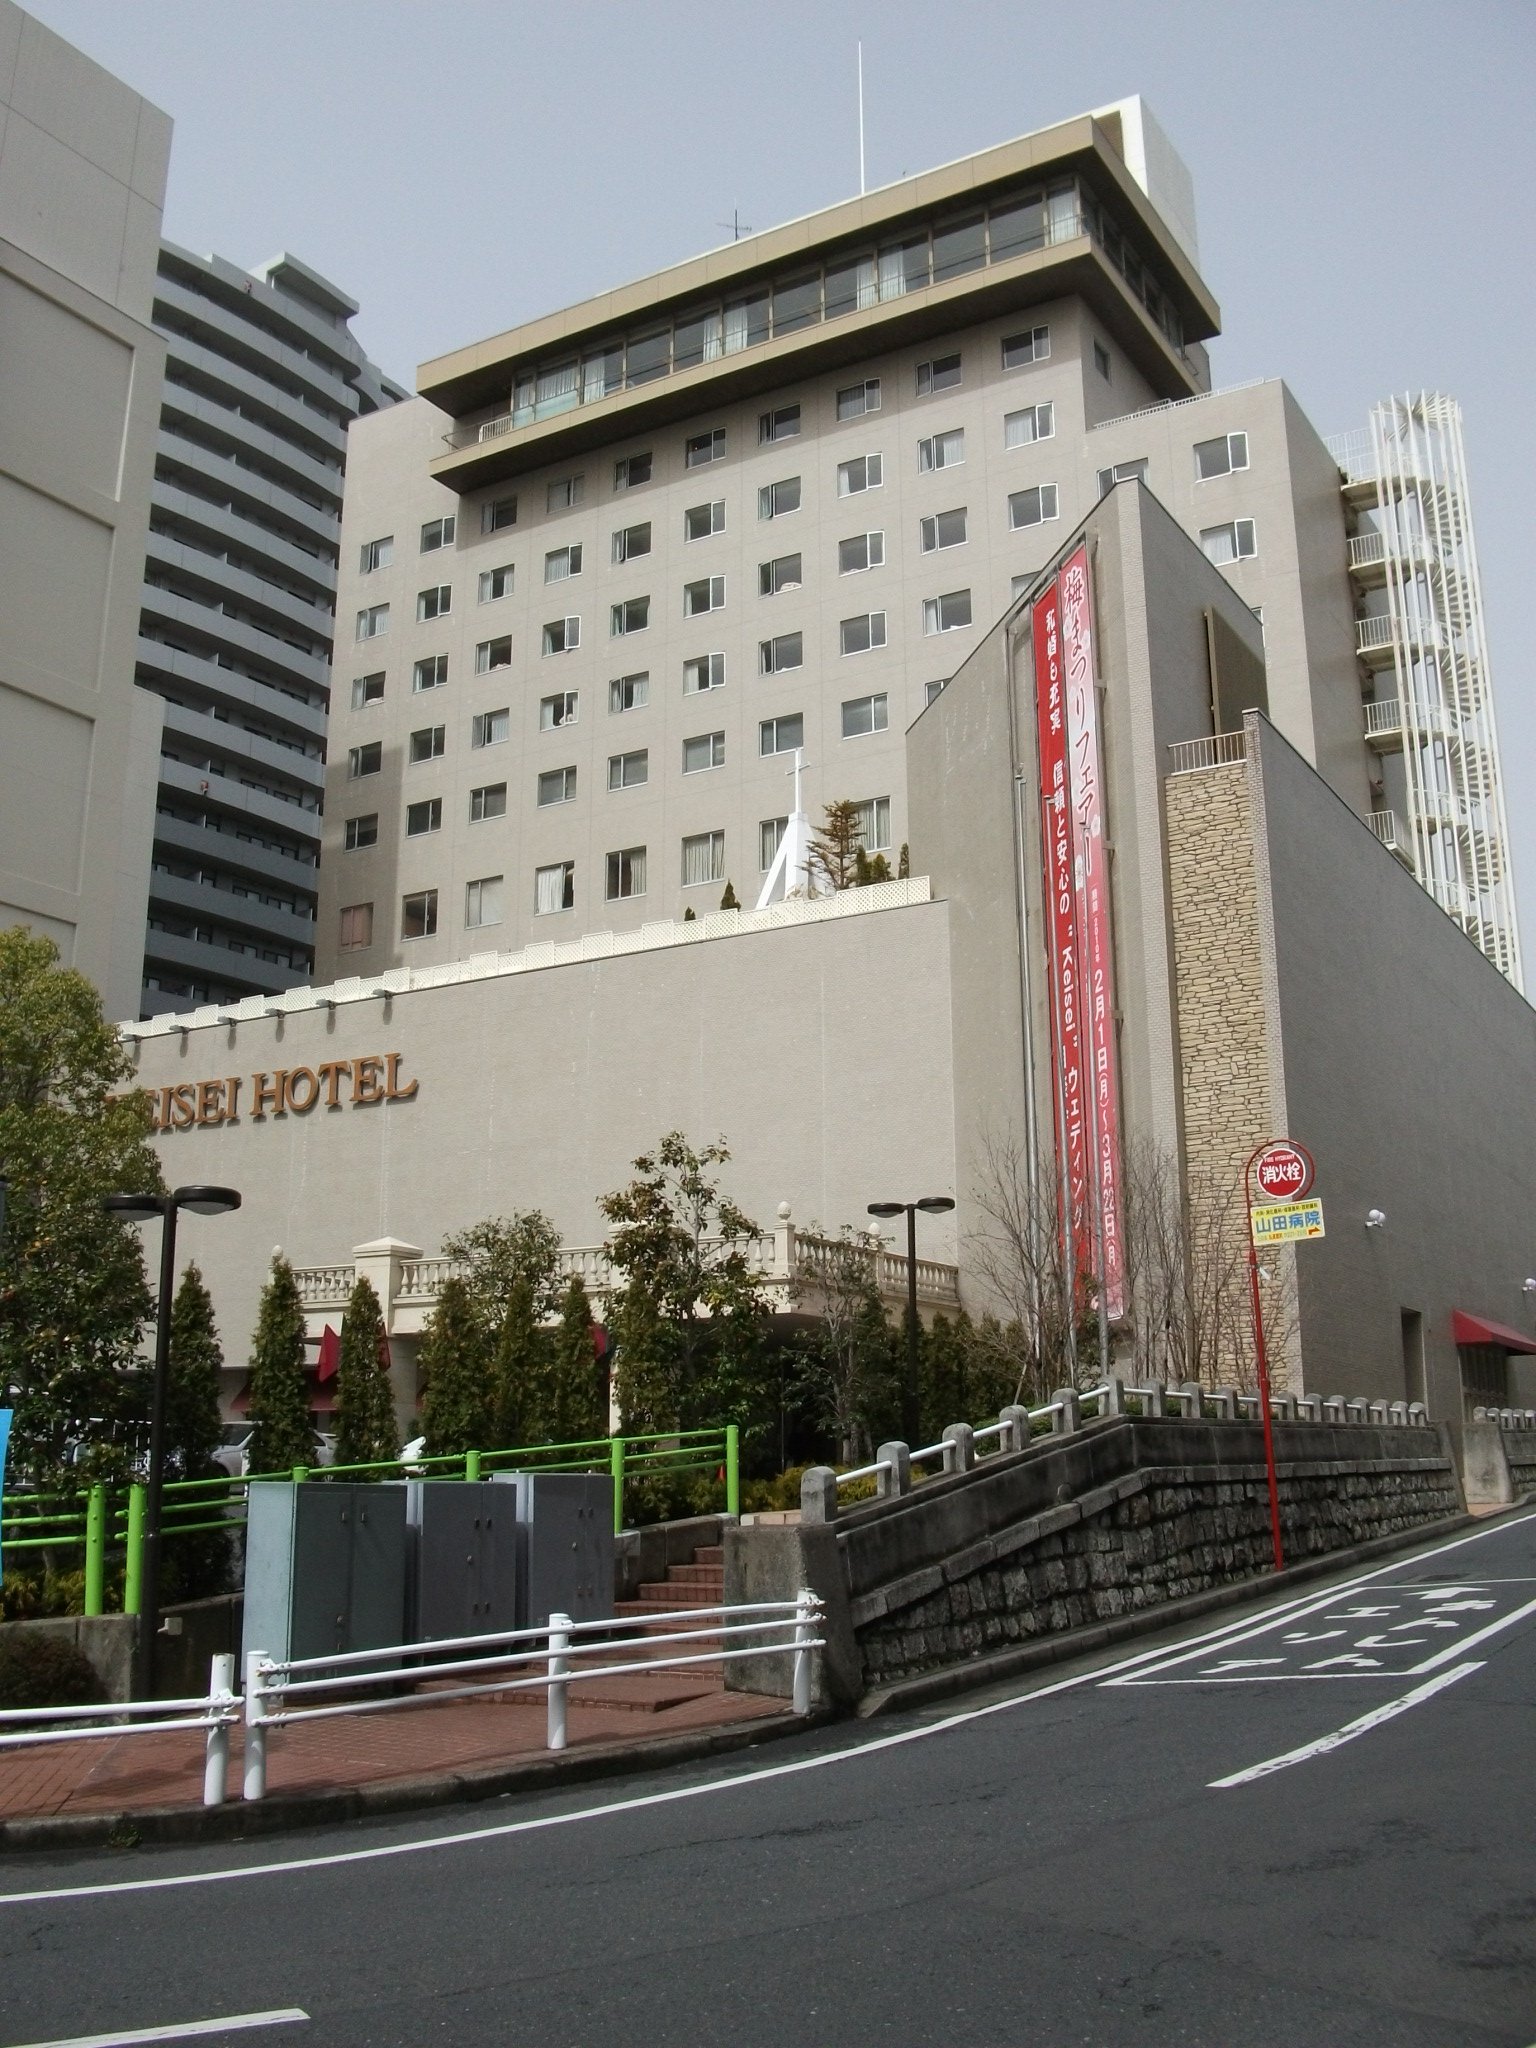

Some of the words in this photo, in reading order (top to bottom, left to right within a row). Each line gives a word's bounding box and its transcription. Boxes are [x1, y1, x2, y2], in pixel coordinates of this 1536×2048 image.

[249, 1052, 418, 1117] HOTEL
[1261, 1161, 1302, 1185] 消火栓
[1255, 1210, 1321, 1233] 山田病院
